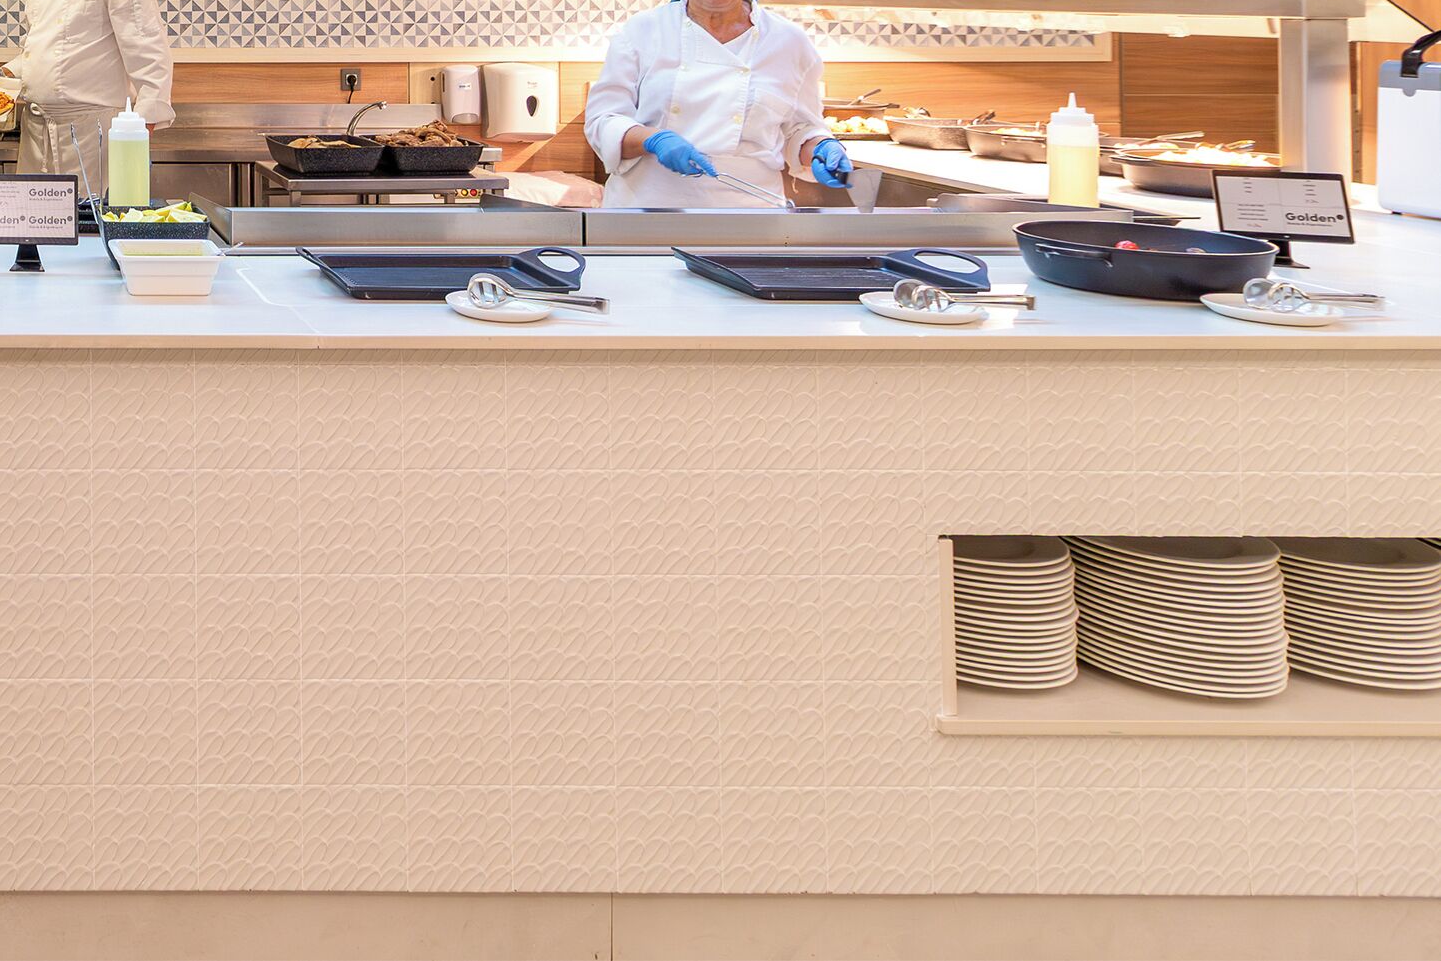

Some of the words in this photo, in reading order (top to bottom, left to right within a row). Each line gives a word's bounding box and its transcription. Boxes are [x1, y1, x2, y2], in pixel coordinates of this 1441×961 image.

[28, 188, 67, 197] Golden
[28, 215, 67, 225] Golden
[1285, 212, 1336, 223] Golden
